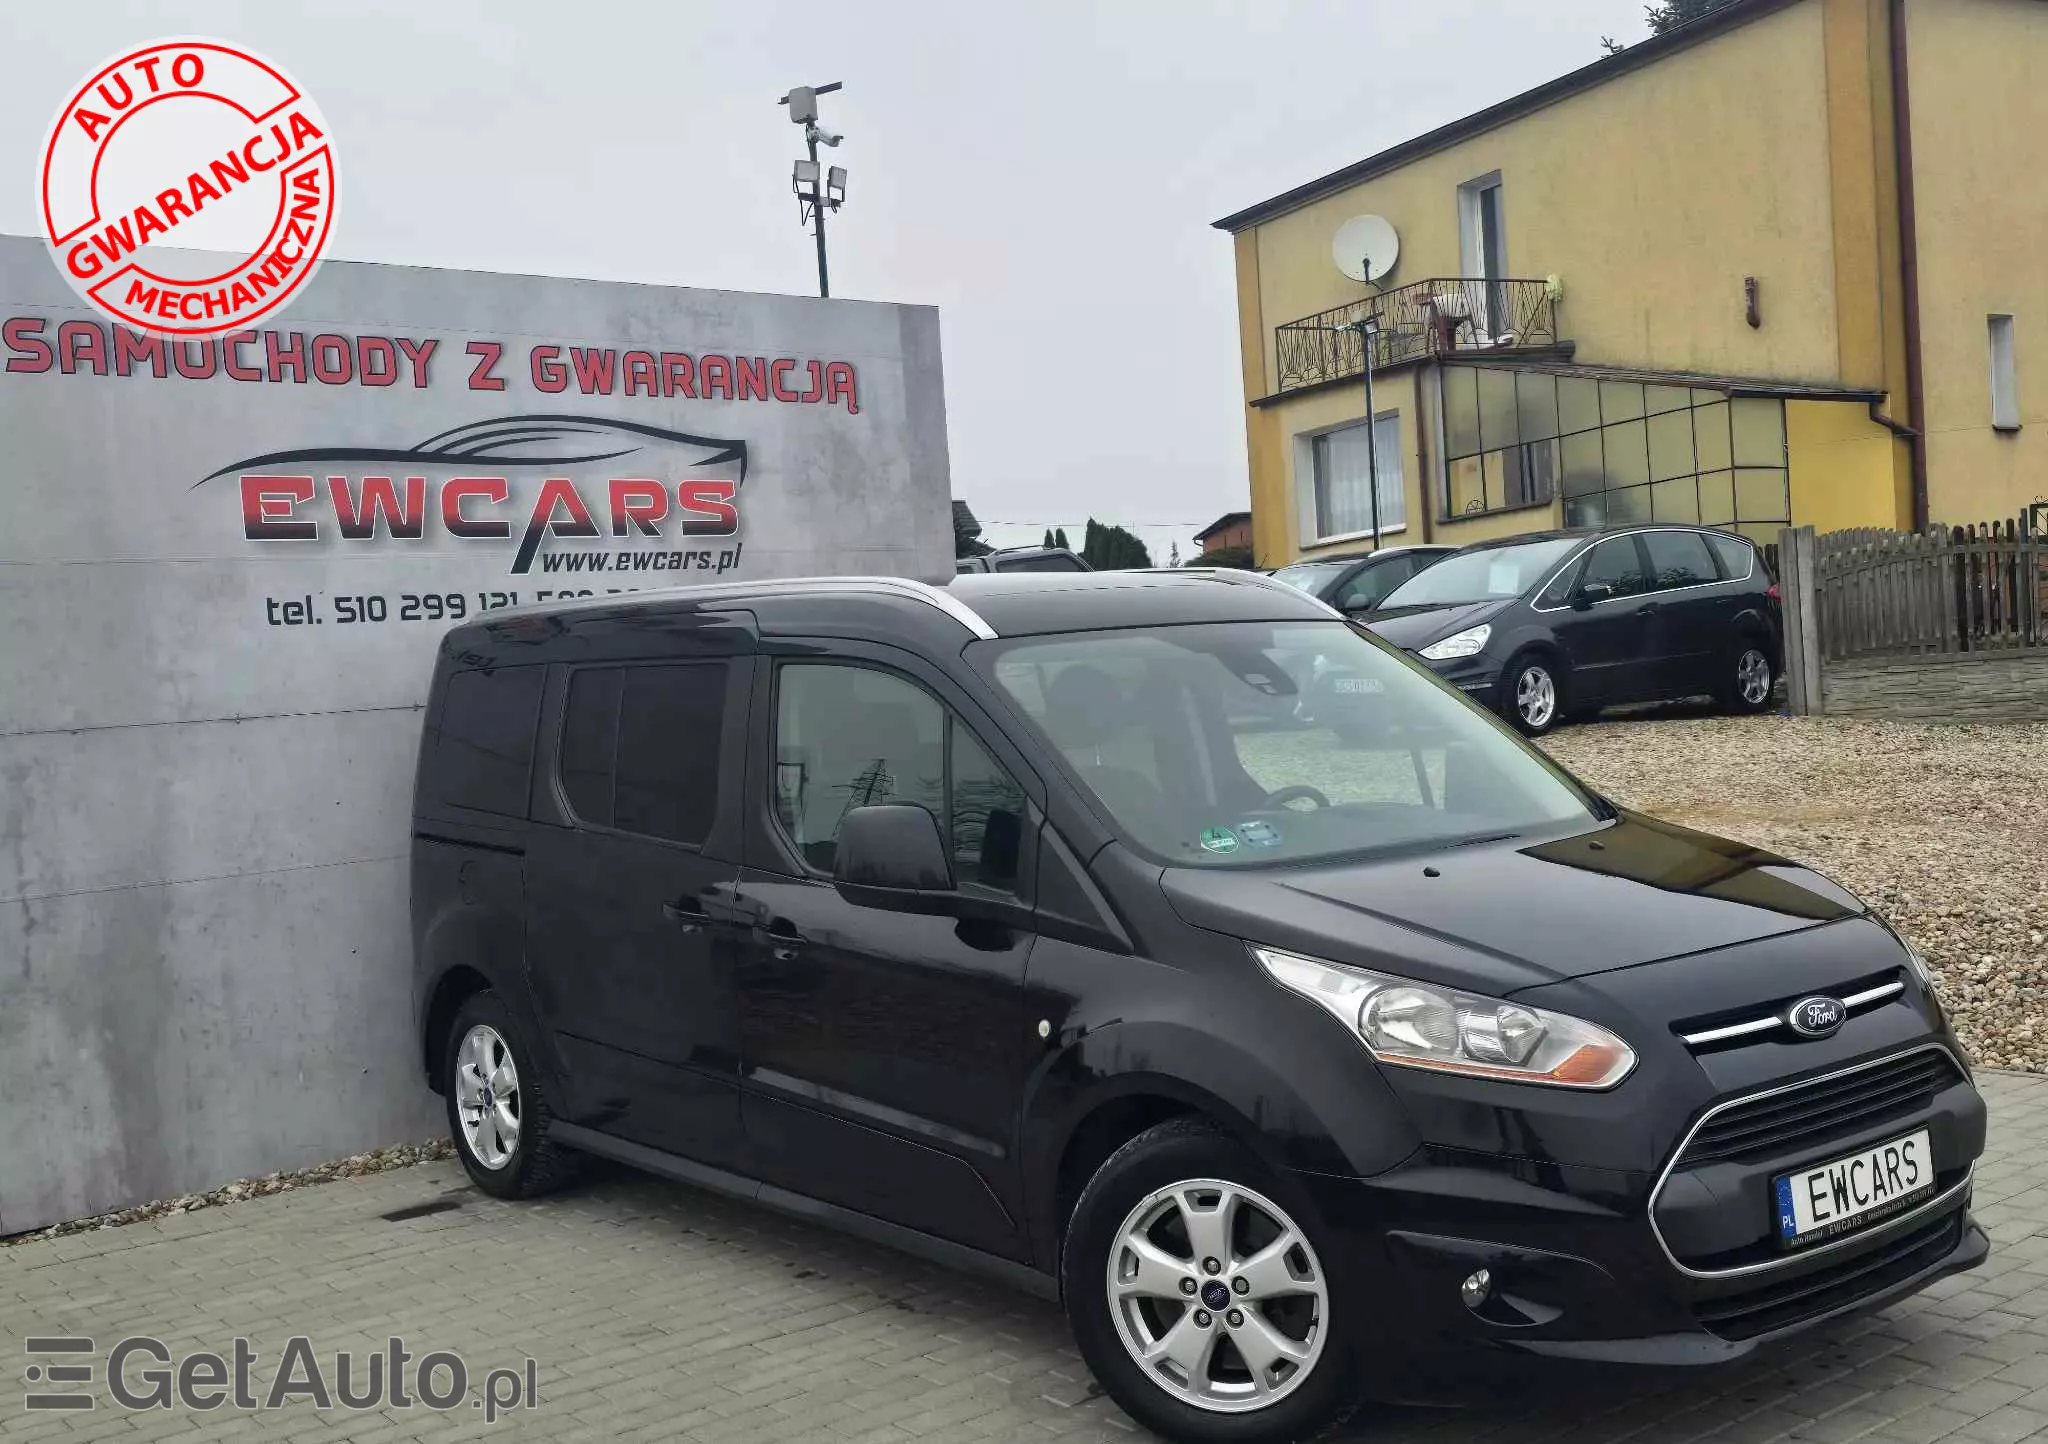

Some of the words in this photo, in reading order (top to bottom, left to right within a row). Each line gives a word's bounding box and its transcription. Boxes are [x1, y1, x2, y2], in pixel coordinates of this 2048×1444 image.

[2, 317, 437, 389] SAMOCHODY
[467, 341, 507, 391] Z
[531, 346, 860, 414] GWARANCJĄ
[240, 475, 740, 575] EWCARS
[541, 544, 742, 574] www.ewcars.pl
[266, 595, 322, 626] tel.
[334, 595, 387, 625] 510
[401, 593, 466, 621] 299
[1807, 1003, 1838, 1027] Ford
[1807, 1140, 1919, 1223] EWCARS
[1782, 1215, 1795, 1229] PL
[1828, 1215, 1863, 1236] EWCARS
